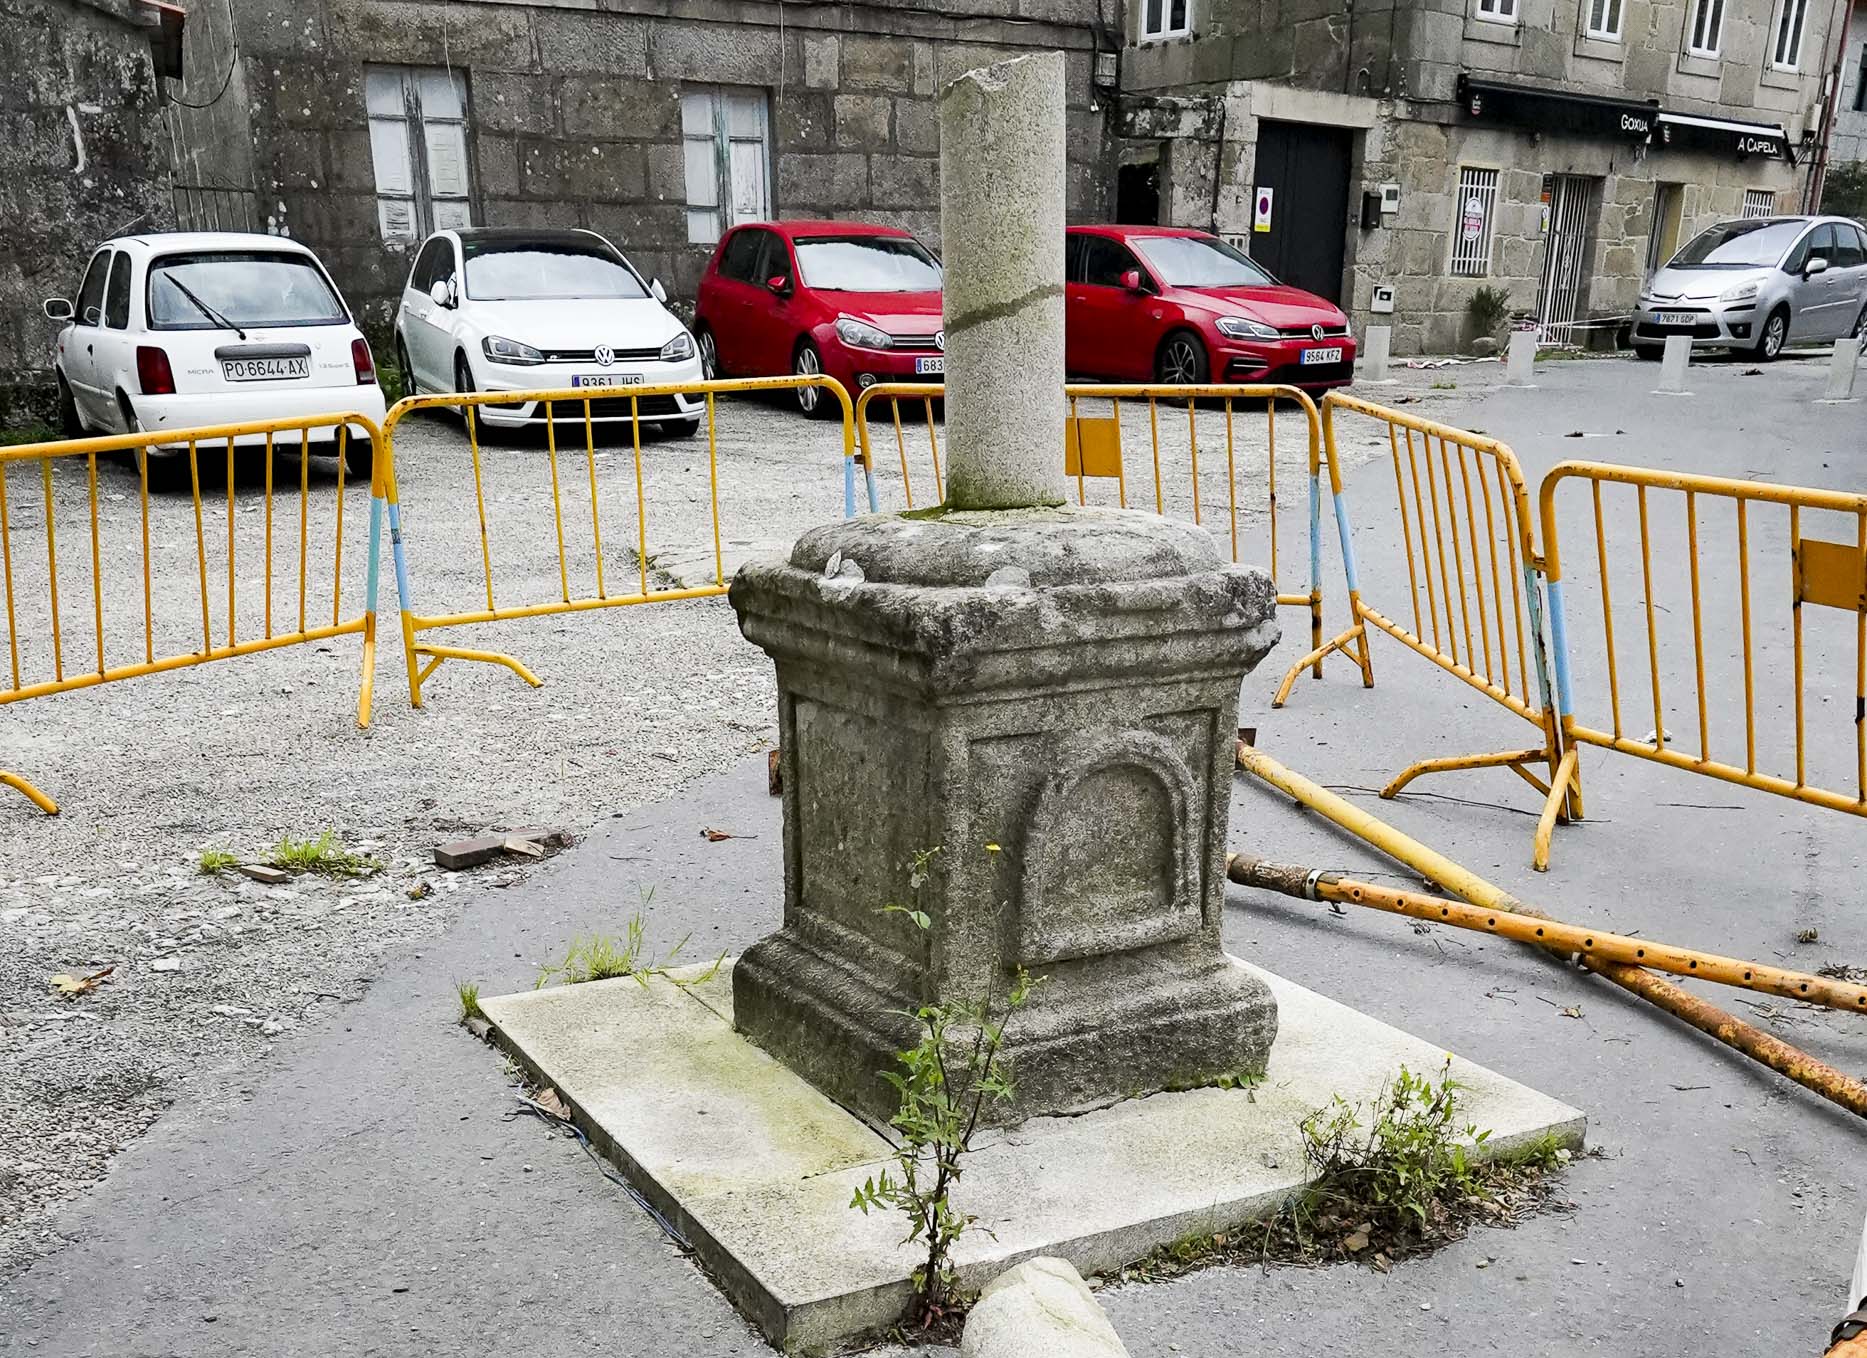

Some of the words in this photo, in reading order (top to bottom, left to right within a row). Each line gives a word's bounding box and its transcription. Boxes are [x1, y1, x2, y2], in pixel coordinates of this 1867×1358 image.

[1737, 137, 1745, 150] A
[1747, 137, 1778, 154] CAPELA
[1326, 349, 1340, 360] KFZ
